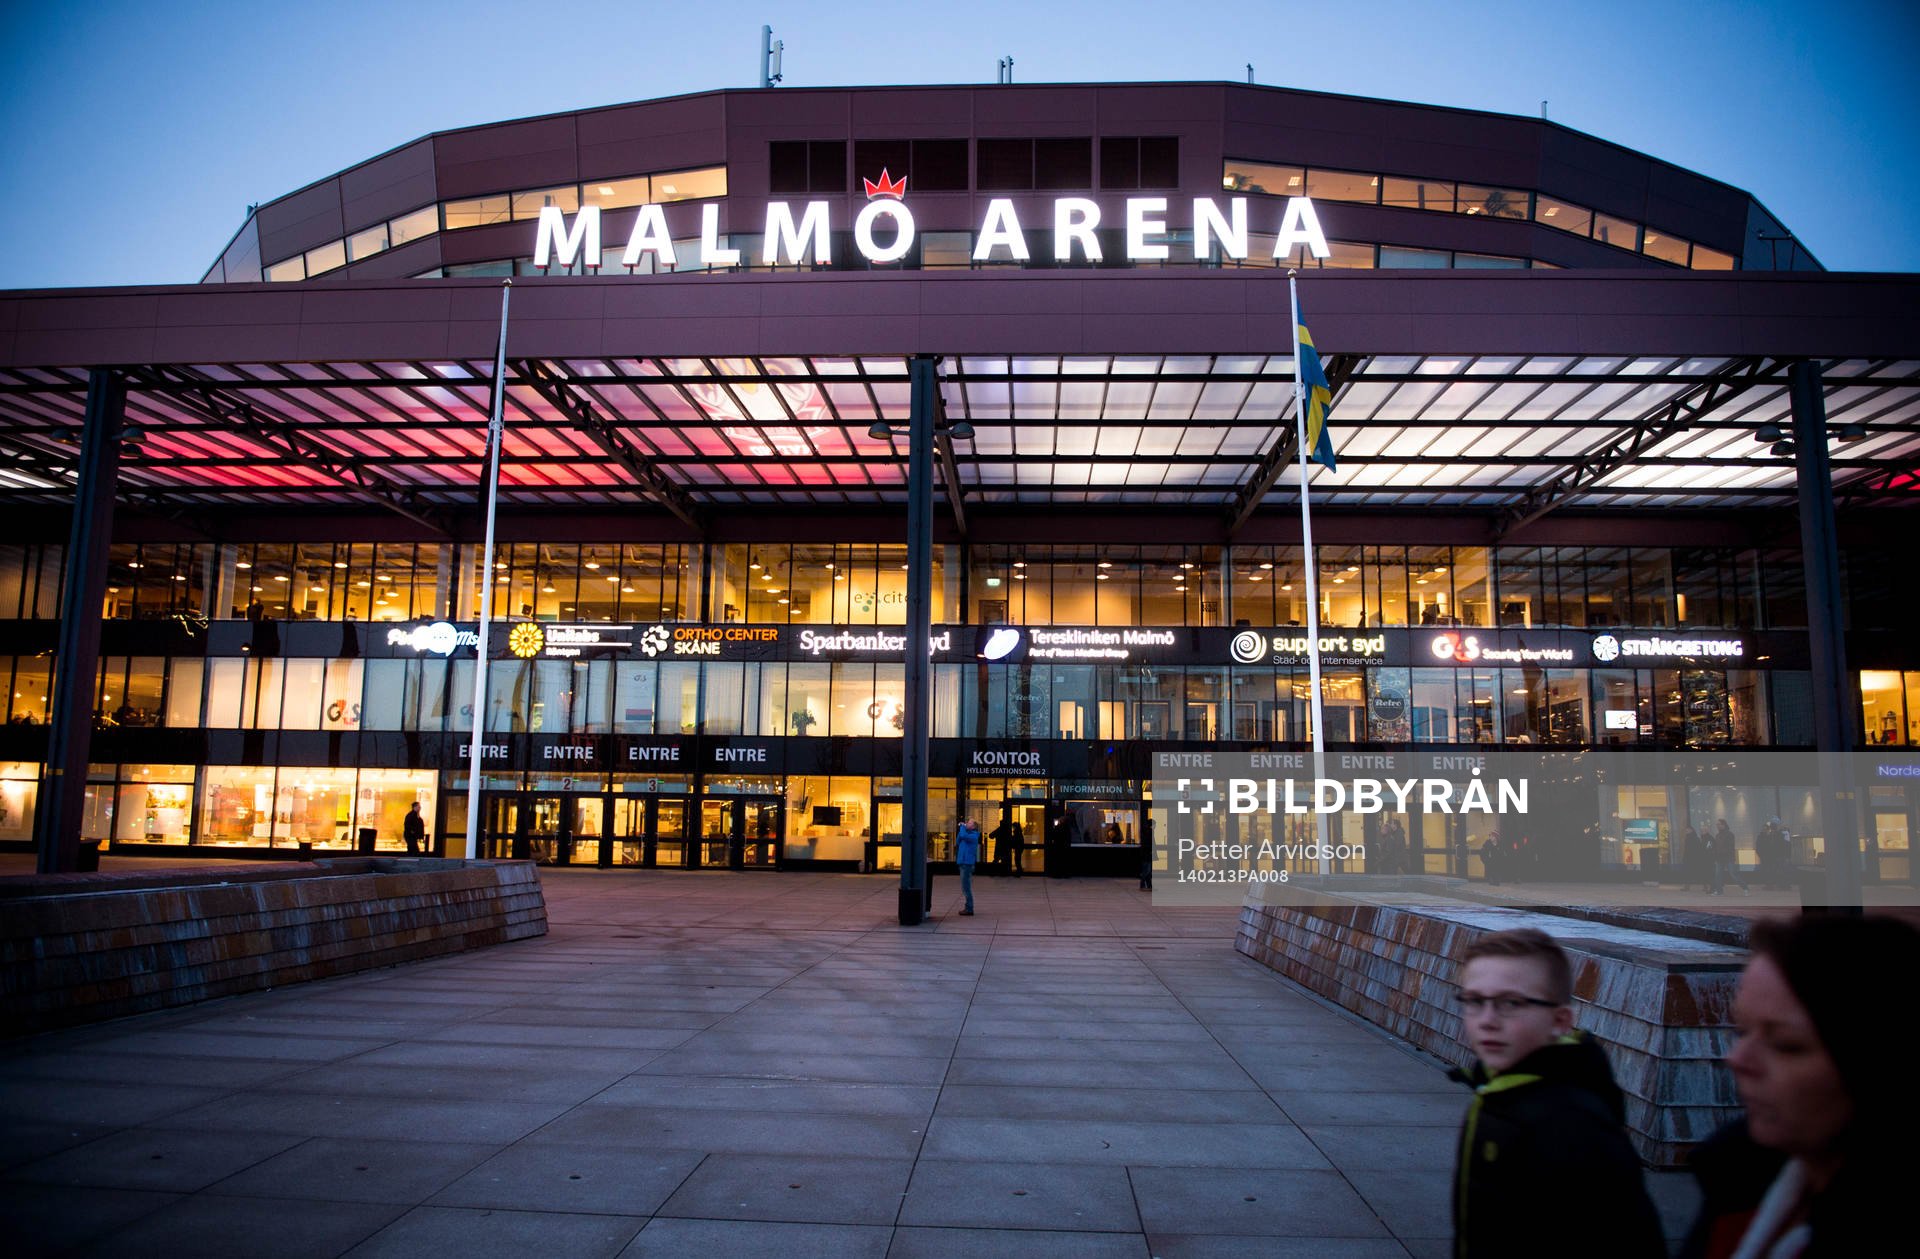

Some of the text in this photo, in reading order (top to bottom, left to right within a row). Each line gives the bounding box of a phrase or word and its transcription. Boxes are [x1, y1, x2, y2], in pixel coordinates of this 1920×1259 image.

[972, 197, 1332, 262] ARENA
[674, 628, 778, 641] ORTHO CENTER
[1030, 629, 1175, 645] Tereskliniken Malmö
[674, 639, 721, 654] SKÅNE
[929, 631, 951, 656] yd
[1273, 634, 1385, 657] suport syd
[1321, 655, 1383, 665] internservice
[543, 745, 594, 760] ENTRE
[628, 746, 680, 761] ENTRE
[715, 748, 767, 762] ENTRE
[972, 751, 1041, 765] KONTOR
[1159, 753, 1213, 768] ENTRE
[1250, 754, 1304, 768] ENTRE
[1341, 755, 1395, 769] ENTRE
[1432, 756, 1486, 770] ENTRE
[991, 767, 1041, 775] STATIONSTORG
[563, 778, 571, 790] 2
[648, 779, 656, 792] 3
[1060, 785, 1123, 793] INFORMATION
